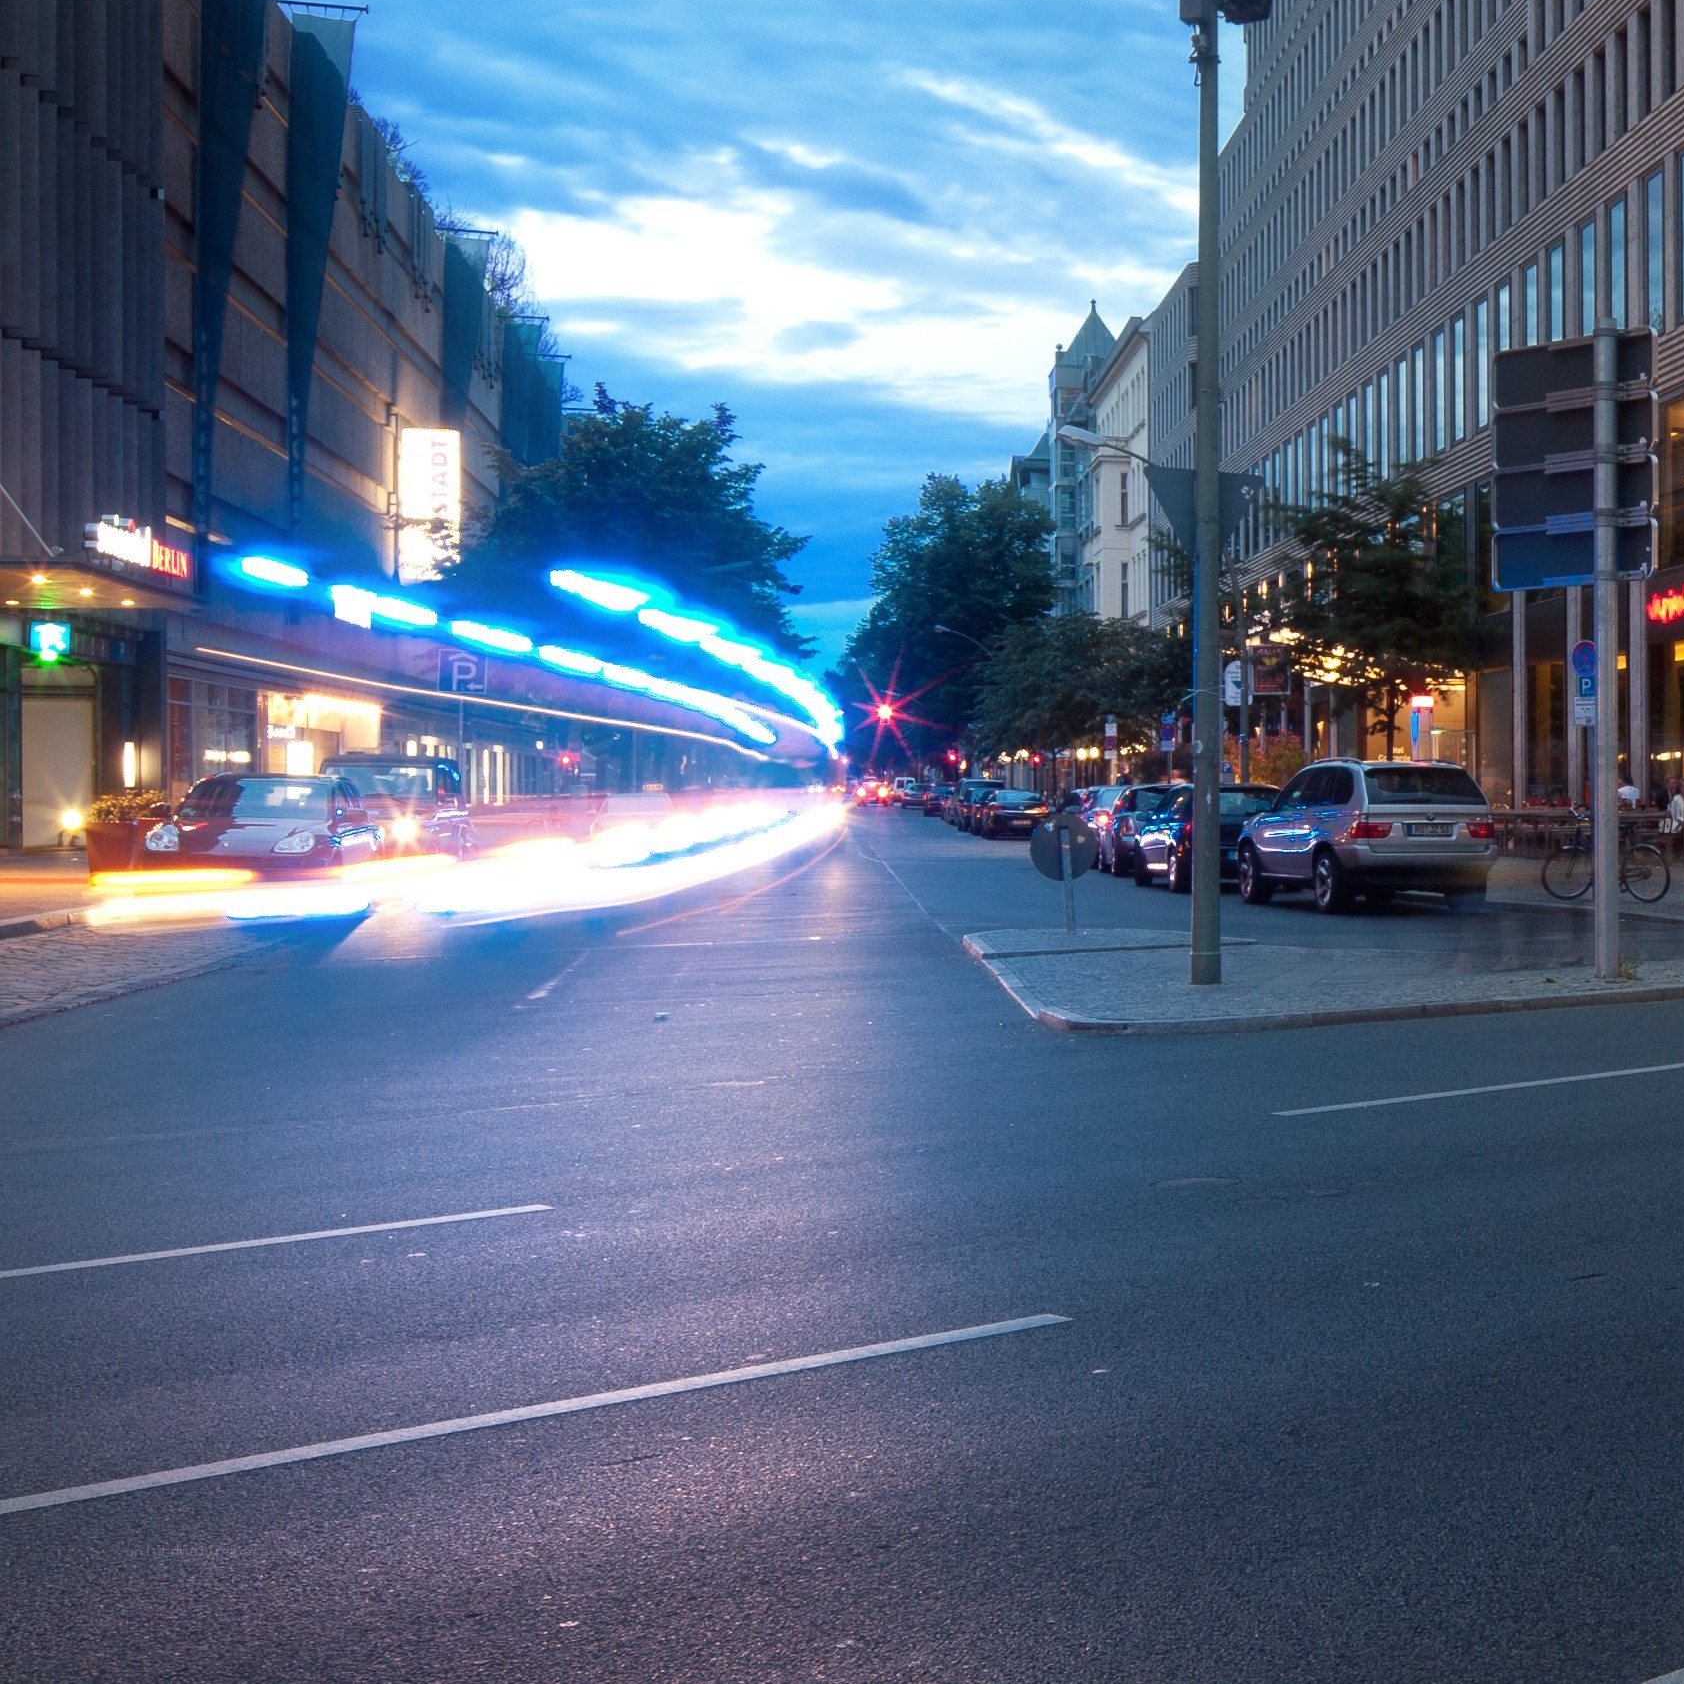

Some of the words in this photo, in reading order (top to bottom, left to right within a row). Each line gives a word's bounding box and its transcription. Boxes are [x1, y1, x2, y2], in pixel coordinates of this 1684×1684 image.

[152, 538, 189, 578] BERLIN
[452, 662, 476, 691] P
[1582, 678, 1591, 695] P
